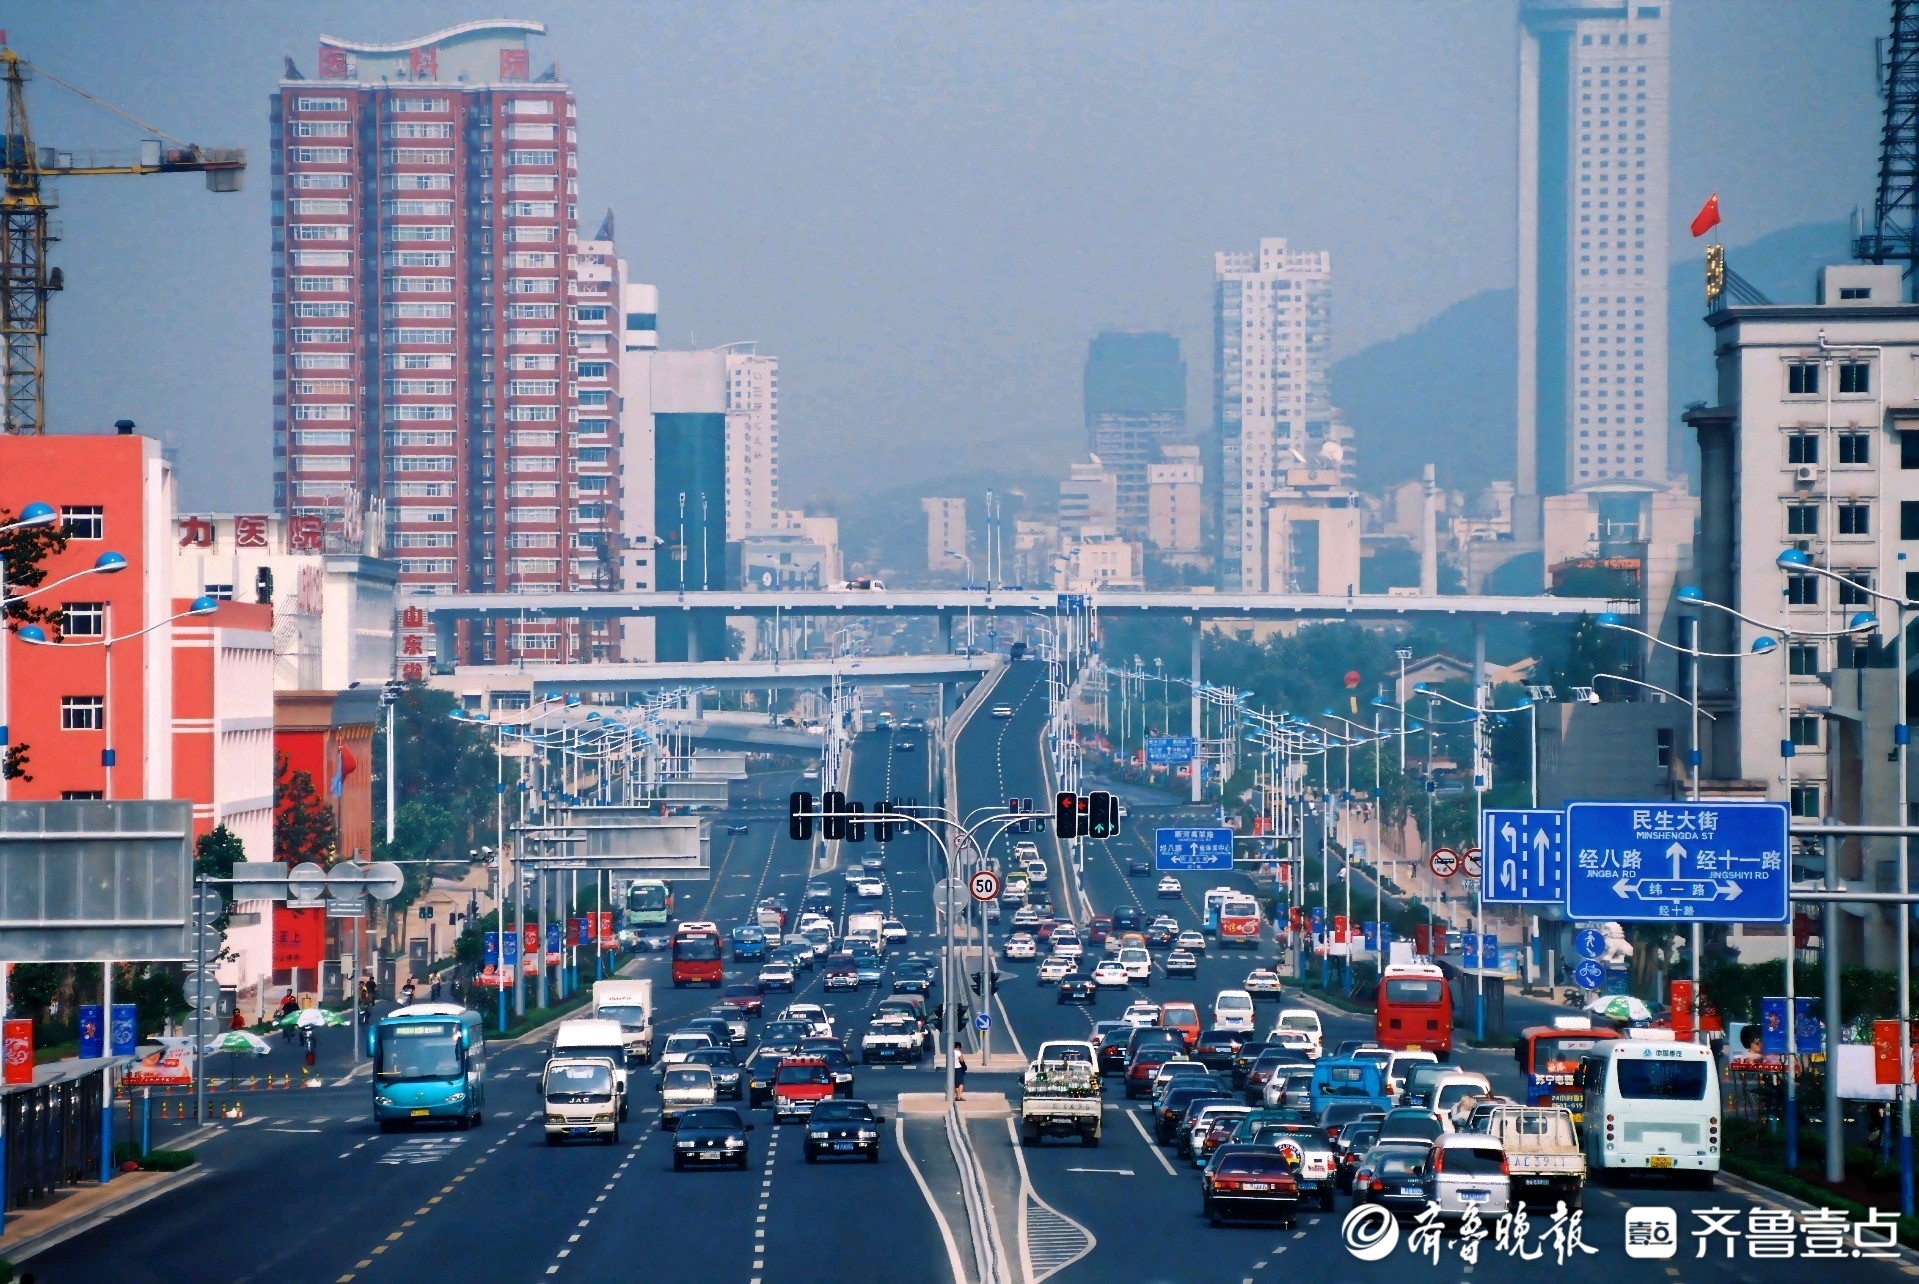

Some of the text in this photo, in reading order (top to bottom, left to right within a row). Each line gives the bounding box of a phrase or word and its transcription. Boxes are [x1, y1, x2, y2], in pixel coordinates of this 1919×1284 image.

[1633, 810, 1718, 831] 民生大街
[1636, 832, 1714, 840] MINSHENGDA ST
[1579, 849, 1642, 870] 经八路
[1697, 851, 1782, 871] 经十一路
[1587, 870, 1636, 878] JINGBA RD
[1709, 872, 1769, 880] JINGSHIYI RD
[976, 880, 992, 892] 50
[1649, 883, 1705, 897] 纬一路
[1659, 906, 1694, 916] 经十路
